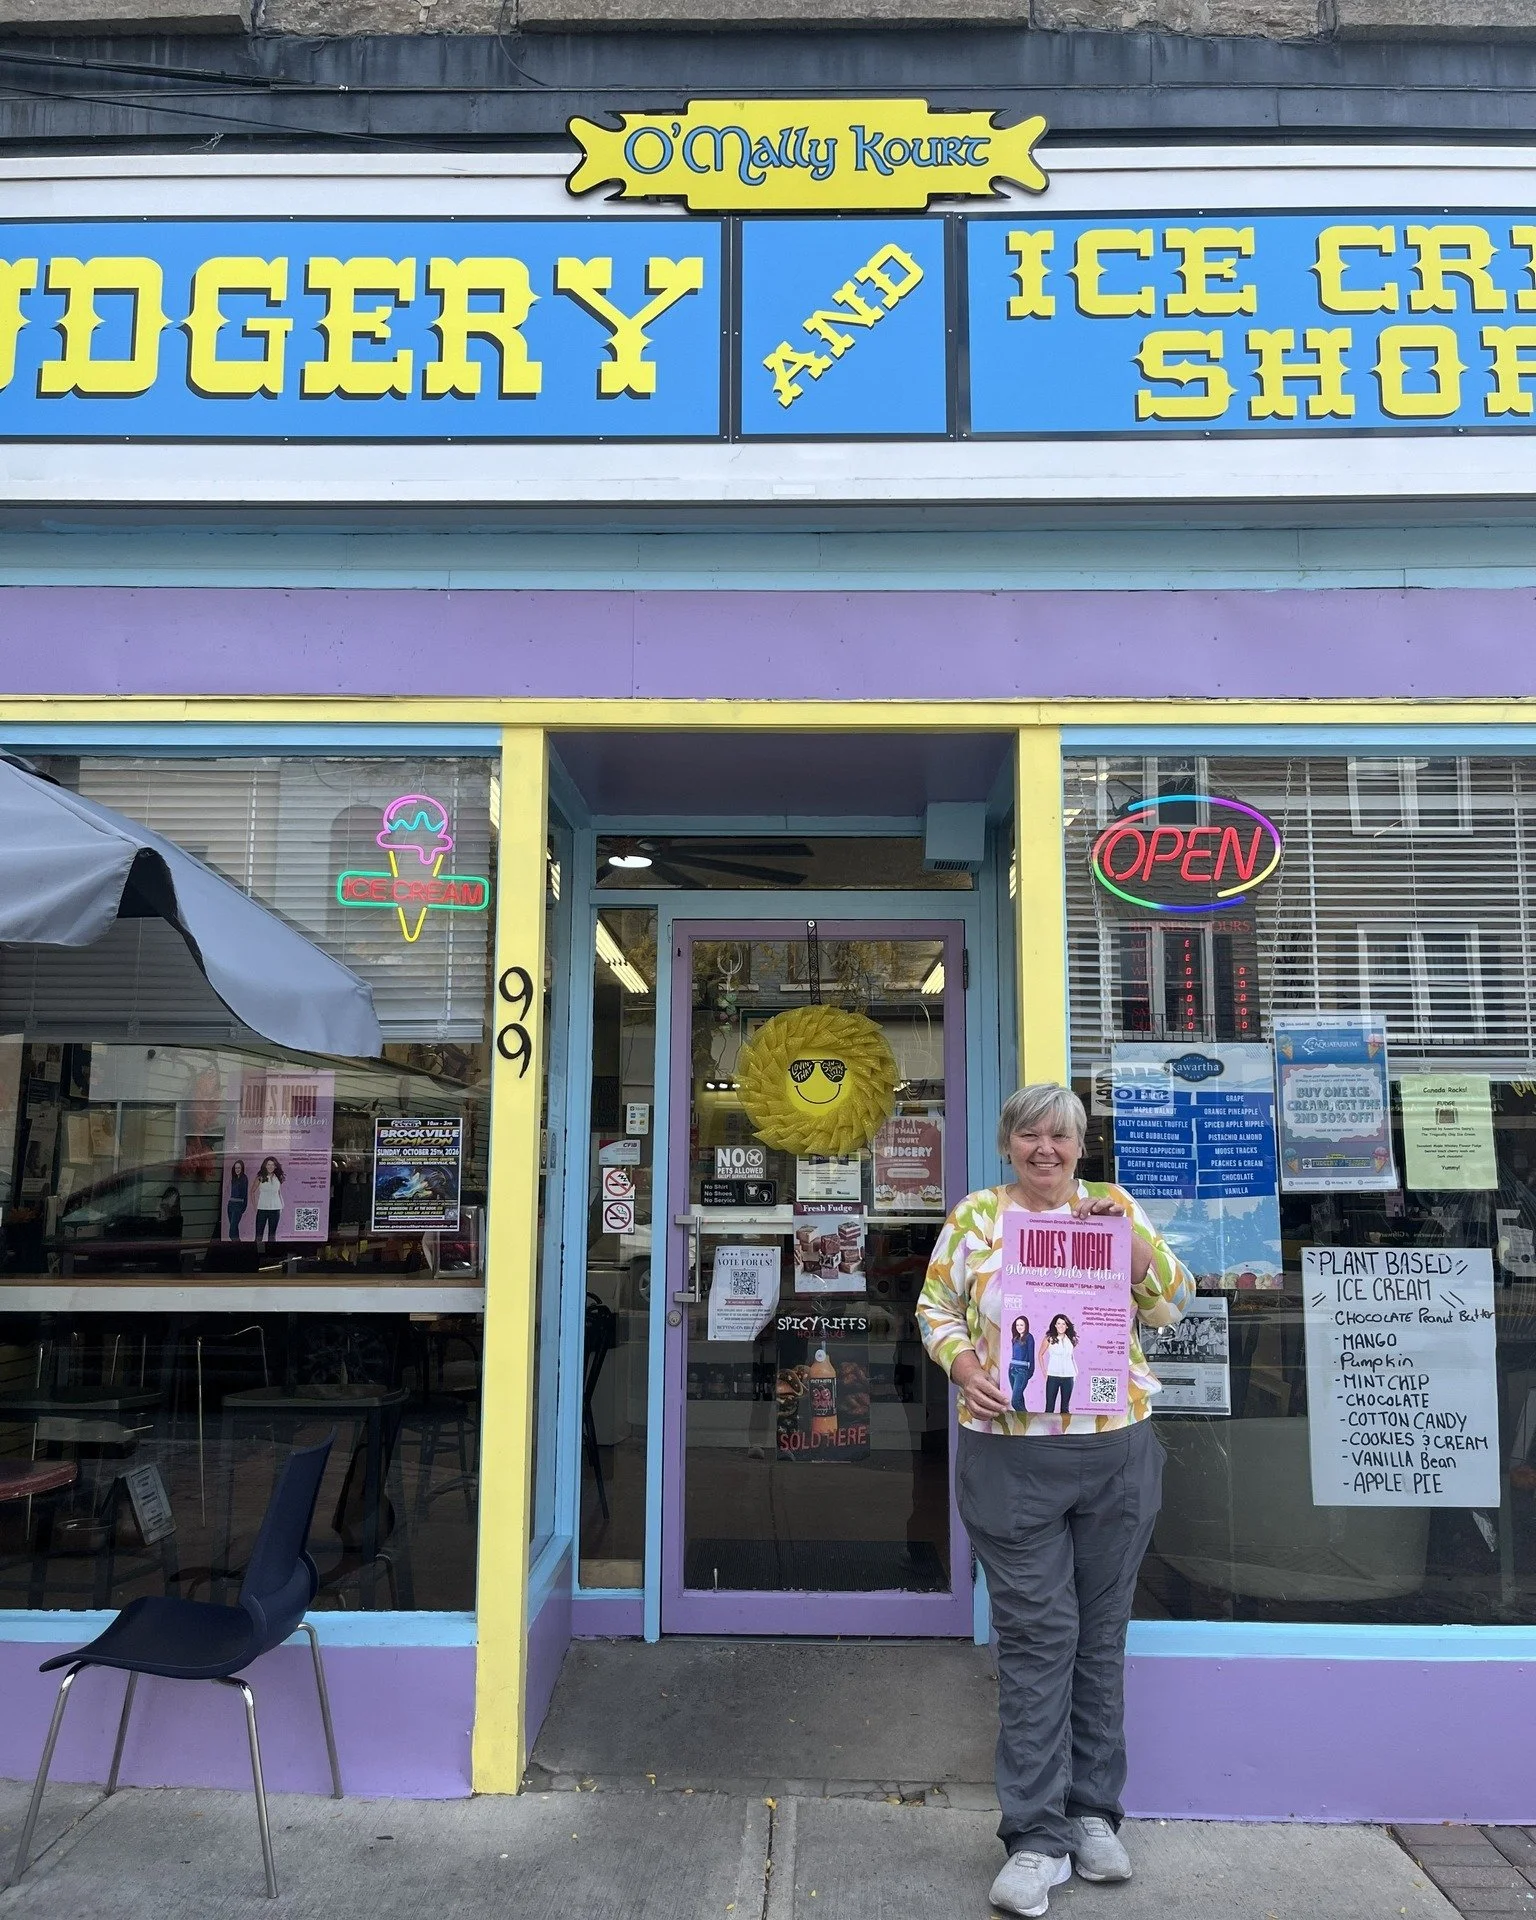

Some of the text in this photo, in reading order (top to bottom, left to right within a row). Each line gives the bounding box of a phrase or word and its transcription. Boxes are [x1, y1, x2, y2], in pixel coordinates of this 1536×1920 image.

[624, 121, 837, 186] O'Mally
[1006, 224, 1536, 319] ICE CR
[0, 257, 704, 400] DGERY
[762, 243, 924, 408] AND
[1103, 825, 1262, 883] OPEN
[344, 878, 483, 905] ICE CREAM
[1170, 1060, 1219, 1073] Kawartha
[1296, 1087, 1370, 1098] BUY ONE ICE
[1133, 1106, 1177, 1115] MAPLE WALNUT
[1204, 1120, 1265, 1129] SPICED APPLE RIPPLE
[1294, 1112, 1375, 1124] 2ND 50% OFF!
[380, 1129, 460, 1138] BROCKVILLE
[1129, 1131, 1180, 1140] BLUE BUBBLEGUM
[1208, 1133, 1263, 1141] PISTACHIO ALMOND
[382, 1137, 453, 1146] COMICON
[377, 1148, 402, 1157] SUNDAY,
[402, 1148, 430, 1156] OCTOBER
[445, 1148, 459, 1156] 2026
[717, 1148, 746, 1167] NO
[884, 1146, 933, 1157] FUDGERY
[1120, 1146, 1185, 1155] DOCKSIDE CAPPUCCINO
[1215, 1146, 1258, 1155] MOOSE TRACKS
[1127, 1160, 1146, 1168] DEATH
[1155, 1161, 1188, 1169] CHOCOLATE
[1211, 1159, 1237, 1167] PEACHES
[1243, 1159, 1264, 1167] CREAM
[1159, 1174, 1179, 1182] CANDY
[1221, 1173, 1254, 1181] CHOCOLATE
[1131, 1188, 1156, 1196] COOKIES
[1224, 1187, 1249, 1195] VANILLA
[803, 1204, 853, 1213] Fresh Fudge
[1019, 1229, 1113, 1271] LADIES NIGHT
[759, 1259, 773, 1267] US!
[1319, 1250, 1453, 1276] PLANT BASED
[1336, 1277, 1432, 1302] ICE CREAM
[777, 1316, 822, 1331] SPICY
[820, 1317, 867, 1330] RIFFS
[1334, 1307, 1496, 1326] CHOCOLATE Peanut Butter
[1343, 1333, 1397, 1350] MANGO
[1340, 1351, 1414, 1373] Pumpkin
[1343, 1373, 1430, 1391] MINT CHIP
[1346, 1393, 1430, 1408] CHOCOLATE
[1348, 1411, 1468, 1433] COTTON CANDY
[779, 1425, 867, 1452] SOLD HERE
[1349, 1431, 1415, 1446] COOKIES
[1433, 1435, 1489, 1451] CREAM
[1352, 1450, 1457, 1470] VANILLA Bean
[1353, 1472, 1443, 1494] APPLE PIE
